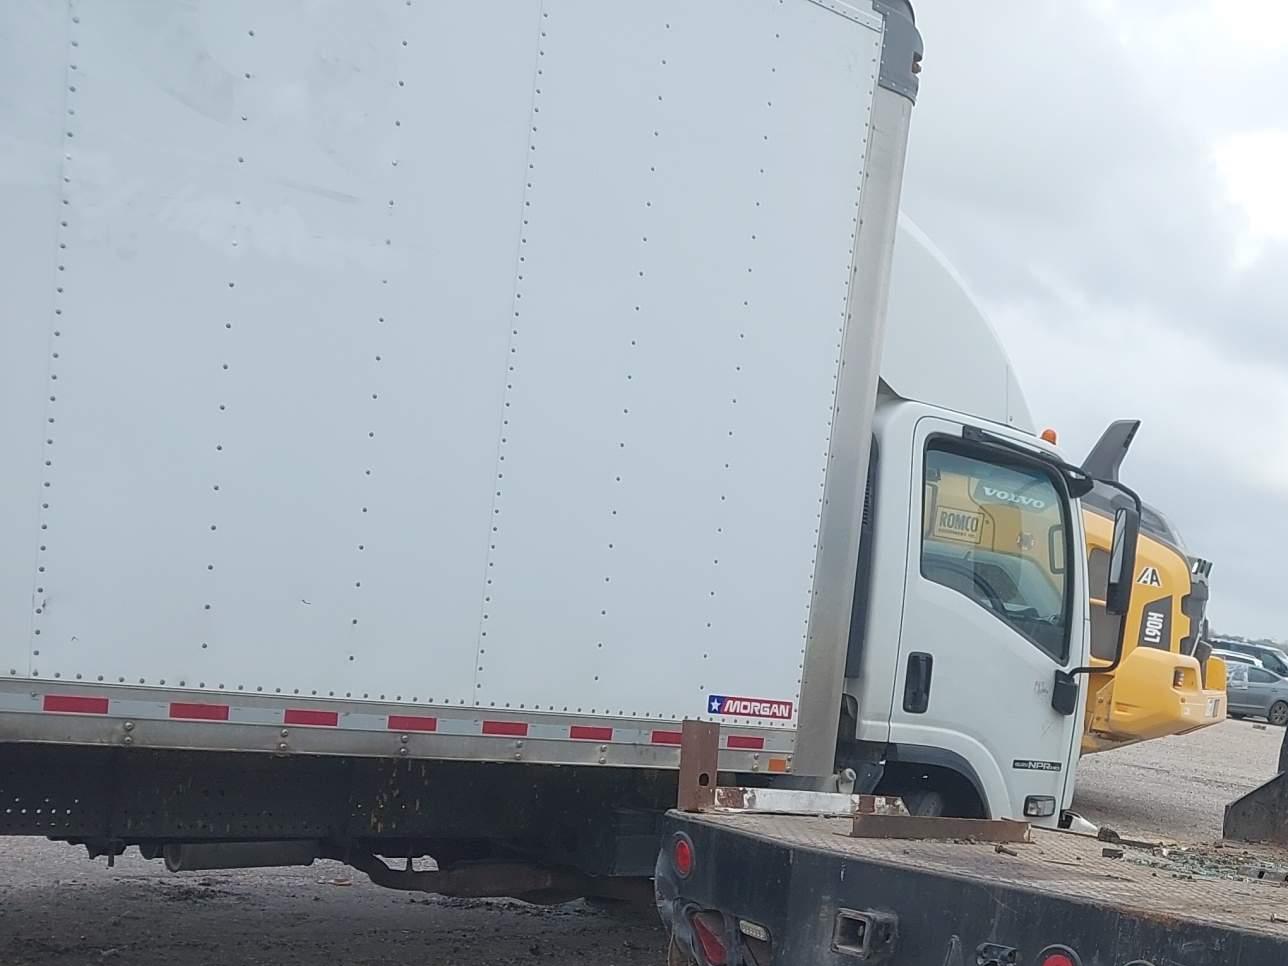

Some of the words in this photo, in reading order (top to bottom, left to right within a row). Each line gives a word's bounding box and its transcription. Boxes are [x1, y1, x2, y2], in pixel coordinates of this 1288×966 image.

[983, 486, 1045, 509] VOLVO
[939, 511, 979, 532] ROMCO
[1143, 611, 1164, 644] L90H
[723, 699, 790, 717] MORGAN
